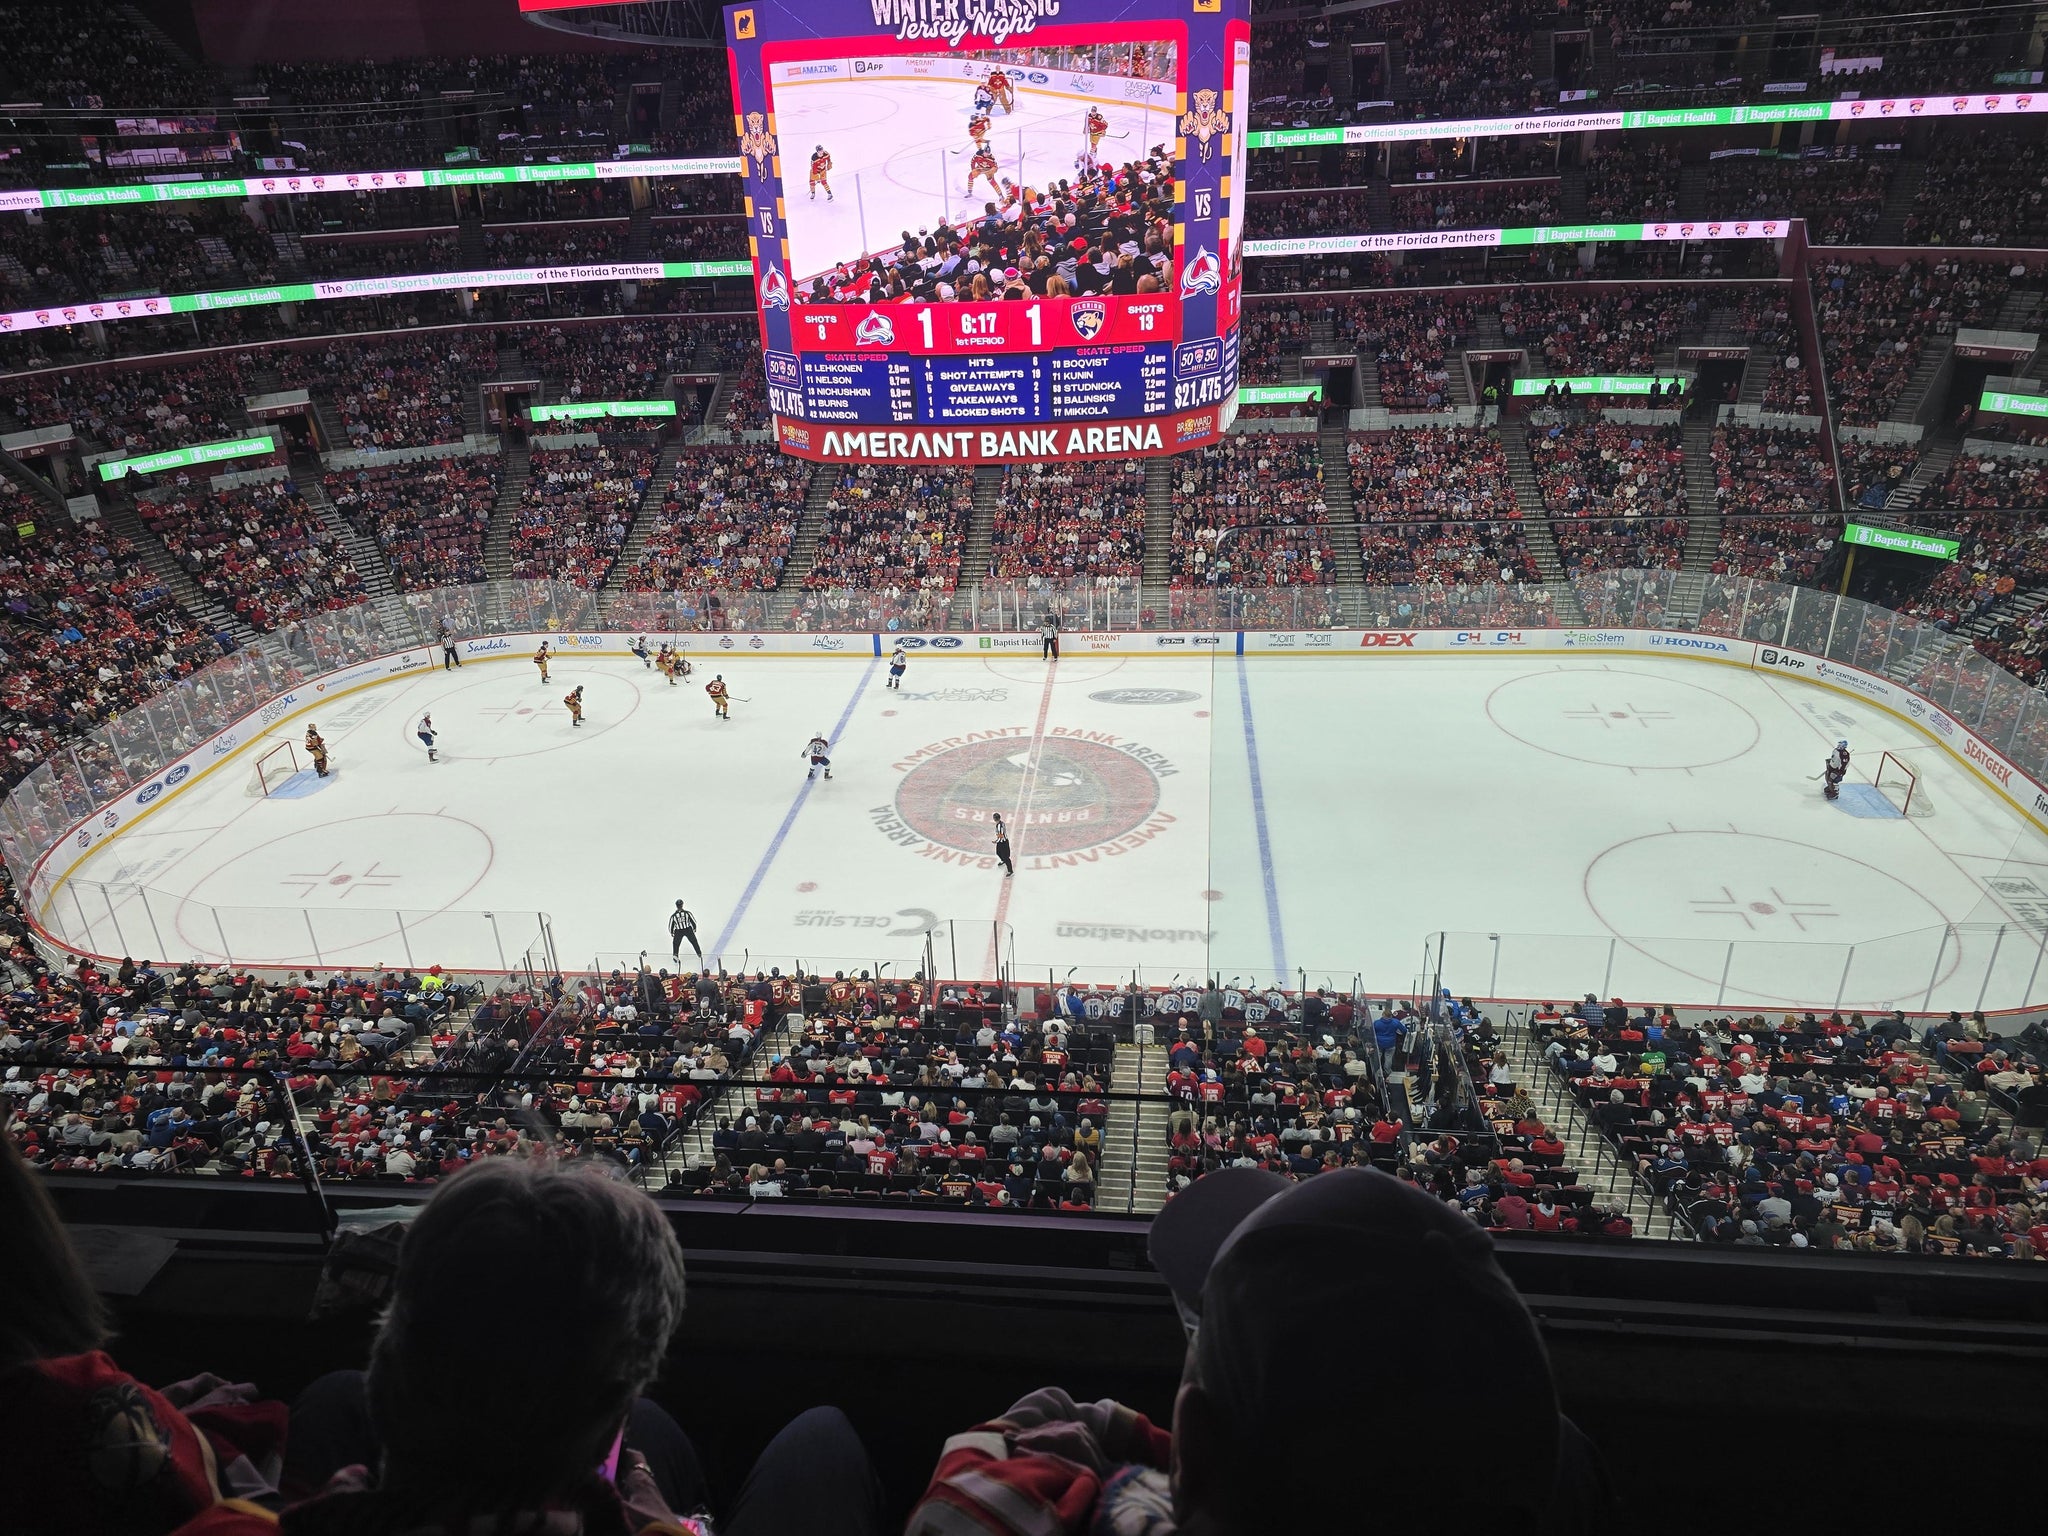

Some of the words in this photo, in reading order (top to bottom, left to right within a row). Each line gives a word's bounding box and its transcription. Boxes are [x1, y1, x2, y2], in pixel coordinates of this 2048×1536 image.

[870, 0, 959, 26] WINTER
[896, 16, 969, 47] Jersey
[972, 9, 1036, 45] Night
[802, 65, 838, 74] AMAZING
[1124, 80, 1150, 90] OMEGA
[1150, 84, 1162, 95] XL
[1647, 114, 1681, 126] Baptist
[1684, 112, 1716, 122] Health
[1750, 110, 1786, 122] Baptist
[1787, 106, 1823, 118] Health
[1276, 134, 1307, 145] Baptist
[1308, 131, 1338, 142] Health
[1346, 130, 1362, 140] The
[1364, 128, 1396, 138] Official
[1398, 126, 1428, 138] Sports
[1429, 124, 1472, 136] Medicine
[1474, 122, 1513, 132] Provider
[1514, 122, 1525, 130] of
[1526, 121, 1540, 130] the
[1542, 119, 1576, 128] Florida
[1578, 116, 1622, 128] Panthers
[445, 172, 474, 184] Baptist
[477, 170, 505, 180] Health
[532, 168, 561, 180] Baptist
[563, 166, 590, 177] Health
[596, 166, 613, 174] The
[614, 164, 643, 173] Official
[644, 164, 670, 174] Sports
[671, 161, 708, 172] Medicine
[69, 190, 105, 204] Baptist
[108, 188, 141, 200] Health
[173, 184, 208, 198] Baptist
[210, 182, 240, 194] Health
[1195, 194, 1212, 218] VS
[760, 211, 774, 235] VS
[1252, 240, 1306, 252] Medicine
[1308, 238, 1358, 250] Provider
[1360, 237, 1373, 248] of
[1375, 236, 1394, 246] the
[1396, 234, 1438, 246] Florida
[1440, 232, 1496, 244] Panthers
[1551, 230, 1583, 242] Baptist
[1584, 228, 1616, 238] Health
[214, 294, 248, 306] Baptist
[250, 290, 281, 301] Health
[320, 284, 343, 295] The
[345, 279, 388, 292] Official
[387, 276, 430, 290] Sports
[432, 272, 485, 286] Medicine
[488, 270, 534, 282] Provider
[536, 270, 548, 280] of
[550, 269, 568, 279] the
[570, 265, 609, 278] Florida
[612, 262, 660, 276] Panthers
[706, 264, 734, 276] Baptist
[1074, 302, 1102, 312] FLORIDA
[1128, 304, 1164, 314] SHOTS
[804, 315, 838, 324] SHOTS
[960, 312, 998, 334] 6:17
[1026, 304, 1042, 346] 1
[1138, 314, 1154, 331] 13
[818, 324, 826, 340] 8
[918, 308, 934, 348] 1
[955, 338, 970, 346] 1st
[970, 336, 1005, 346] PERIOD
[1076, 347, 1111, 356] SKATE
[1112, 345, 1146, 354] SPEED
[1180, 352, 1194, 367] 50
[1204, 348, 1218, 362] 50
[1507, 352, 1520, 360] 121
[1724, 350, 1739, 359] 122
[824, 354, 857, 362] SKATE
[858, 354, 889, 362] SPEED
[926, 359, 931, 370] 4
[968, 358, 995, 368] HITS
[1063, 358, 1109, 368] BOQVIST
[1304, 358, 1316, 368] 119
[1340, 358, 1353, 366] 120
[770, 360, 778, 374] 50
[786, 364, 797, 377] 50
[814, 364, 863, 373] LEHKONEN
[940, 371, 968, 380] SHOT
[969, 370, 1024, 380] ATTEMPTS
[1032, 368, 1041, 379] 19
[806, 376, 814, 384] 11
[816, 376, 852, 384] NELSON
[1052, 372, 1060, 381] 71
[1064, 371, 1094, 380] KUNIN
[816, 388, 871, 396] NICHUSHKIN
[950, 383, 1016, 392] GIVEAWAYS
[1034, 381, 1040, 392] 2
[1064, 382, 1122, 392] STUDNICKA
[1174, 376, 1222, 410] $21,475
[1615, 381, 1644, 392] Baptist
[769, 386, 804, 418] $21,475
[928, 396, 933, 406] 1
[948, 396, 1018, 405] TAKEAWAYS
[1034, 394, 1040, 404] 3
[1064, 394, 1116, 404] BALINSKIS
[1260, 390, 1288, 401] Baptist
[620, 406, 645, 414] Baptist
[646, 404, 669, 413] Health
[818, 400, 849, 408] BURNS
[2009, 399, 2046, 412] Baptist
[552, 408, 578, 418] Baptist
[578, 406, 602, 415] Health
[818, 411, 859, 420] MANSON
[942, 408, 989, 418] BLOCKED
[990, 407, 1026, 416] SHOTS
[1034, 406, 1040, 416] 2
[1054, 408, 1062, 417] 77
[1064, 406, 1109, 416] MIKKOLA
[822, 430, 974, 458] AMERANT
[980, 429, 1060, 458] BANK
[1066, 423, 1164, 454] ARENA
[206, 446, 236, 461] Baptist
[238, 442, 265, 454] Health
[156, 454, 184, 468] Health
[1874, 534, 1909, 548] Baptist
[1910, 540, 1946, 554] Health
[900, 638, 922, 648] Ford
[935, 638, 957, 648] Ford
[993, 638, 1020, 648] Baptist
[1080, 634, 1121, 642] AMERANT
[1360, 632, 1418, 647] DEX
[1456, 632, 1482, 642] CH
[1497, 632, 1522, 642] CH
[1578, 633, 1625, 642] BioStem
[467, 638, 511, 653] Sandals
[1664, 637, 1729, 652] HONDA
[1835, 672, 1860, 685] CENTERS
[1859, 678, 1870, 688] OF
[1868, 681, 1889, 696] FLORIDA
[259, 700, 283, 718] OMEGA
[282, 694, 298, 709] XL
[263, 709, 284, 725] SPORT
[892, 726, 1028, 773] AMERANT
[1051, 726, 1124, 746] BANK
[1117, 742, 1180, 778] ARENA
[1963, 738, 2014, 788] SEATGEEK
[169, 766, 190, 784] Ford
[142, 784, 163, 802] Ford
[868, 804, 926, 847] ARENA
[1025, 811, 1178, 870] AMERANT
[914, 843, 1001, 870] BANK
[793, 915, 892, 928] CELSIUS
[1056, 925, 1220, 944] AutoNation
[1185, 996, 1198, 1009] 92
[1228, 994, 1238, 1007] 17
[746, 1004, 755, 1015] 16
[1089, 1004, 1099, 1018] 18
